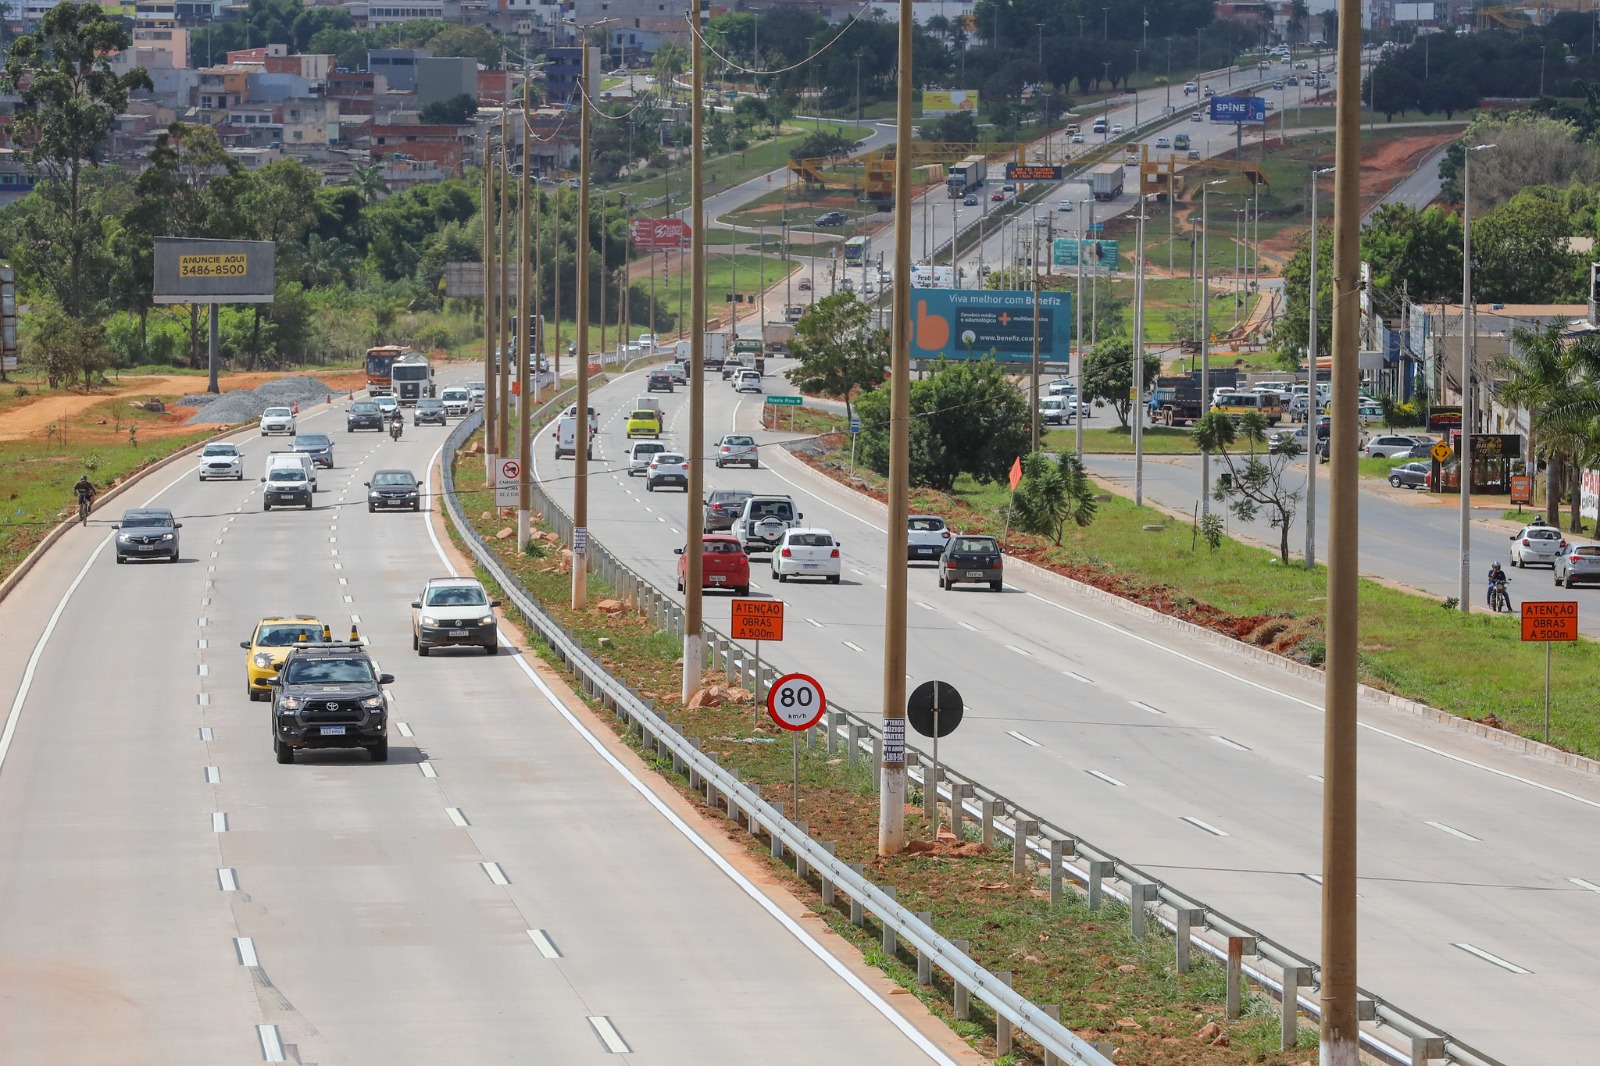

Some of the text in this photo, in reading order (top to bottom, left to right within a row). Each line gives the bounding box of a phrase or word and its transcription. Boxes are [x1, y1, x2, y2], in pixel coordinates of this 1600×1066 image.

[1216, 102, 1246, 112] SPINE
[182, 264, 244, 275] 3486-8500
[949, 294, 968, 303] Viva
[970, 295, 1002, 304] melhor
[736, 604, 780, 615] ATENÇÃO
[1526, 604, 1574, 617] ATENÇÃO
[742, 618, 771, 627] OBRAS
[1534, 619, 1566, 628] OBRAS
[749, 629, 774, 638] 500m
[1541, 630, 1568, 638] 500m
[781, 687, 812, 707] 80
